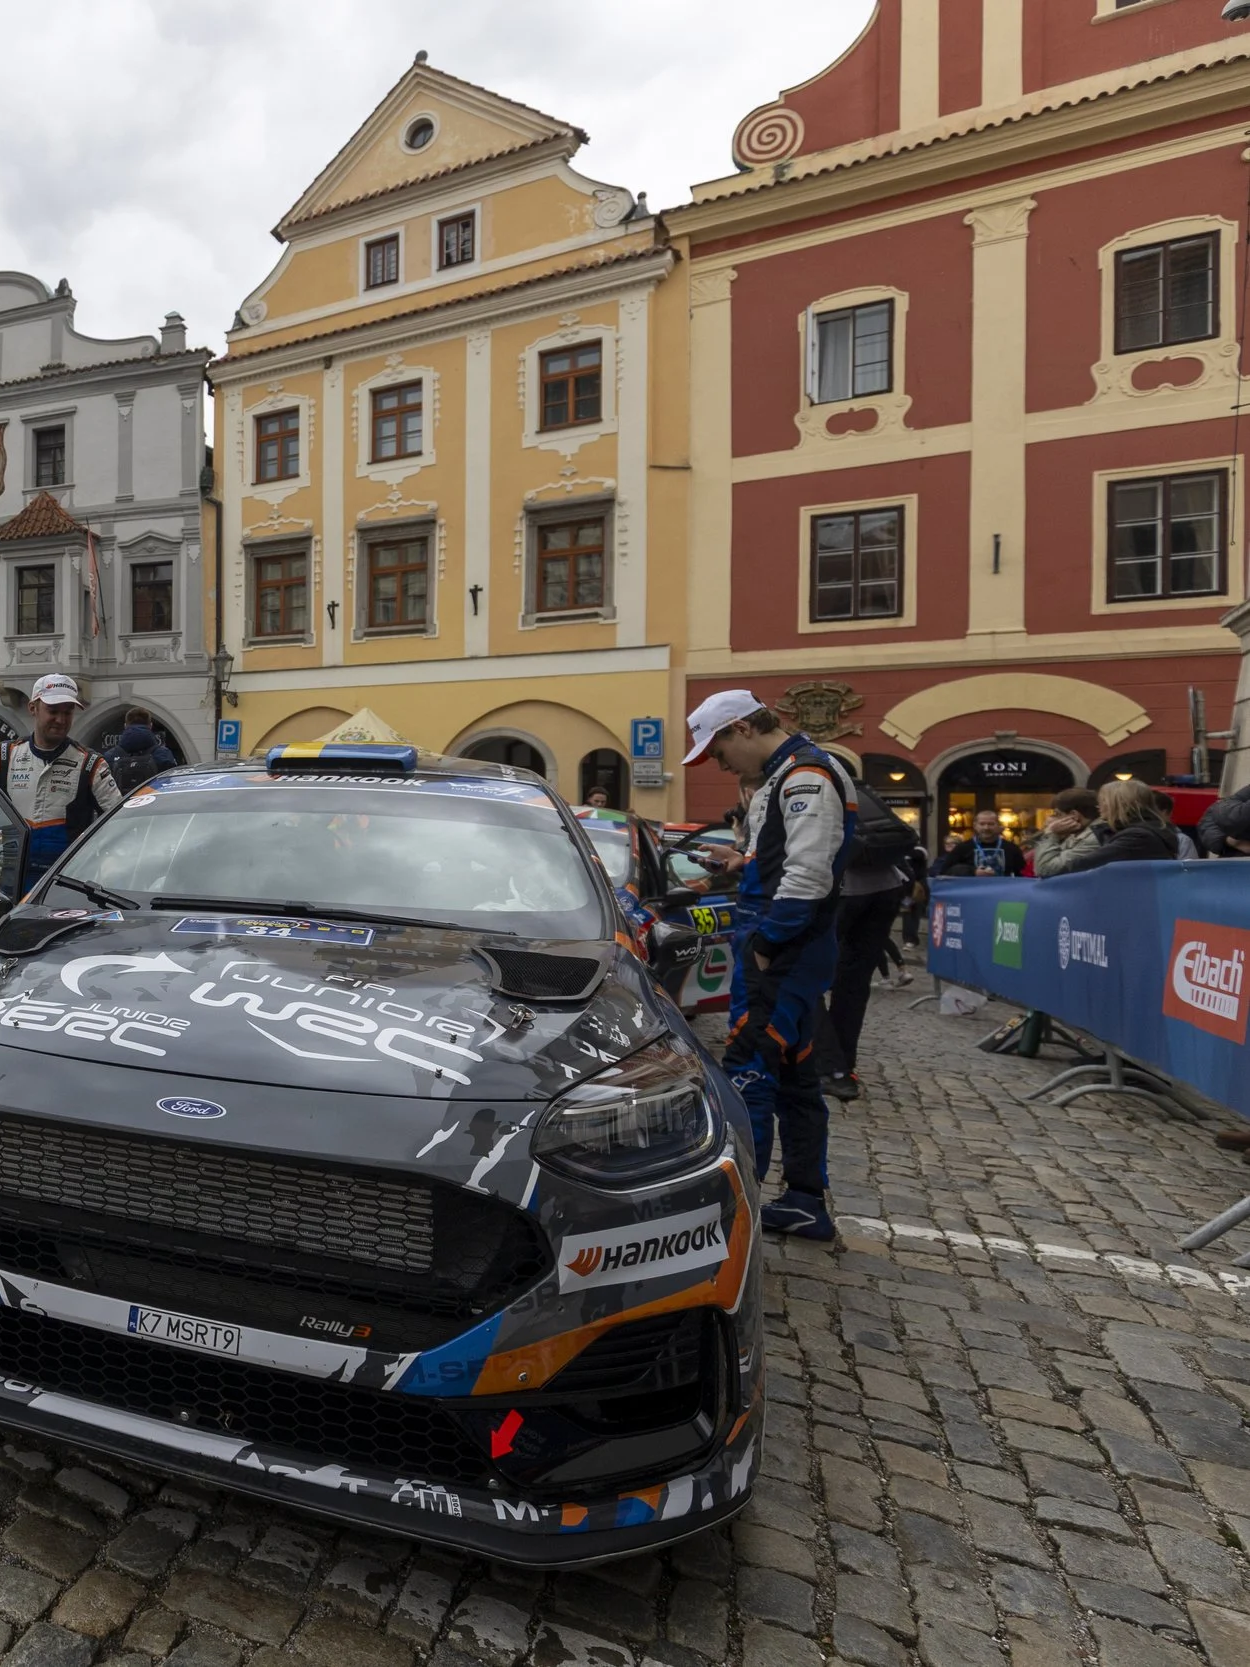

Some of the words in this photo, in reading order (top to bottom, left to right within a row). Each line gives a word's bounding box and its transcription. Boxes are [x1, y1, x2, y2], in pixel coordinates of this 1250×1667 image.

[222, 724, 235, 741] P
[638, 724, 656, 746] P
[981, 762, 1027, 771] TONI
[245, 925, 292, 937] 34
[692, 907, 715, 935] 35
[1071, 930, 1109, 969] OPTIMAL
[1173, 941, 1243, 1006] Eibach
[326, 974, 396, 997] FIA
[231, 971, 476, 1040] JUNIOR
[71, 1003, 192, 1032] JUNIOR
[171, 1100, 211, 1117] Ford
[129, 1321, 136, 1330] PL
[136, 1308, 157, 1335] K7
[165, 1313, 236, 1350] MSRT9
[299, 1315, 371, 1339] Rally3
